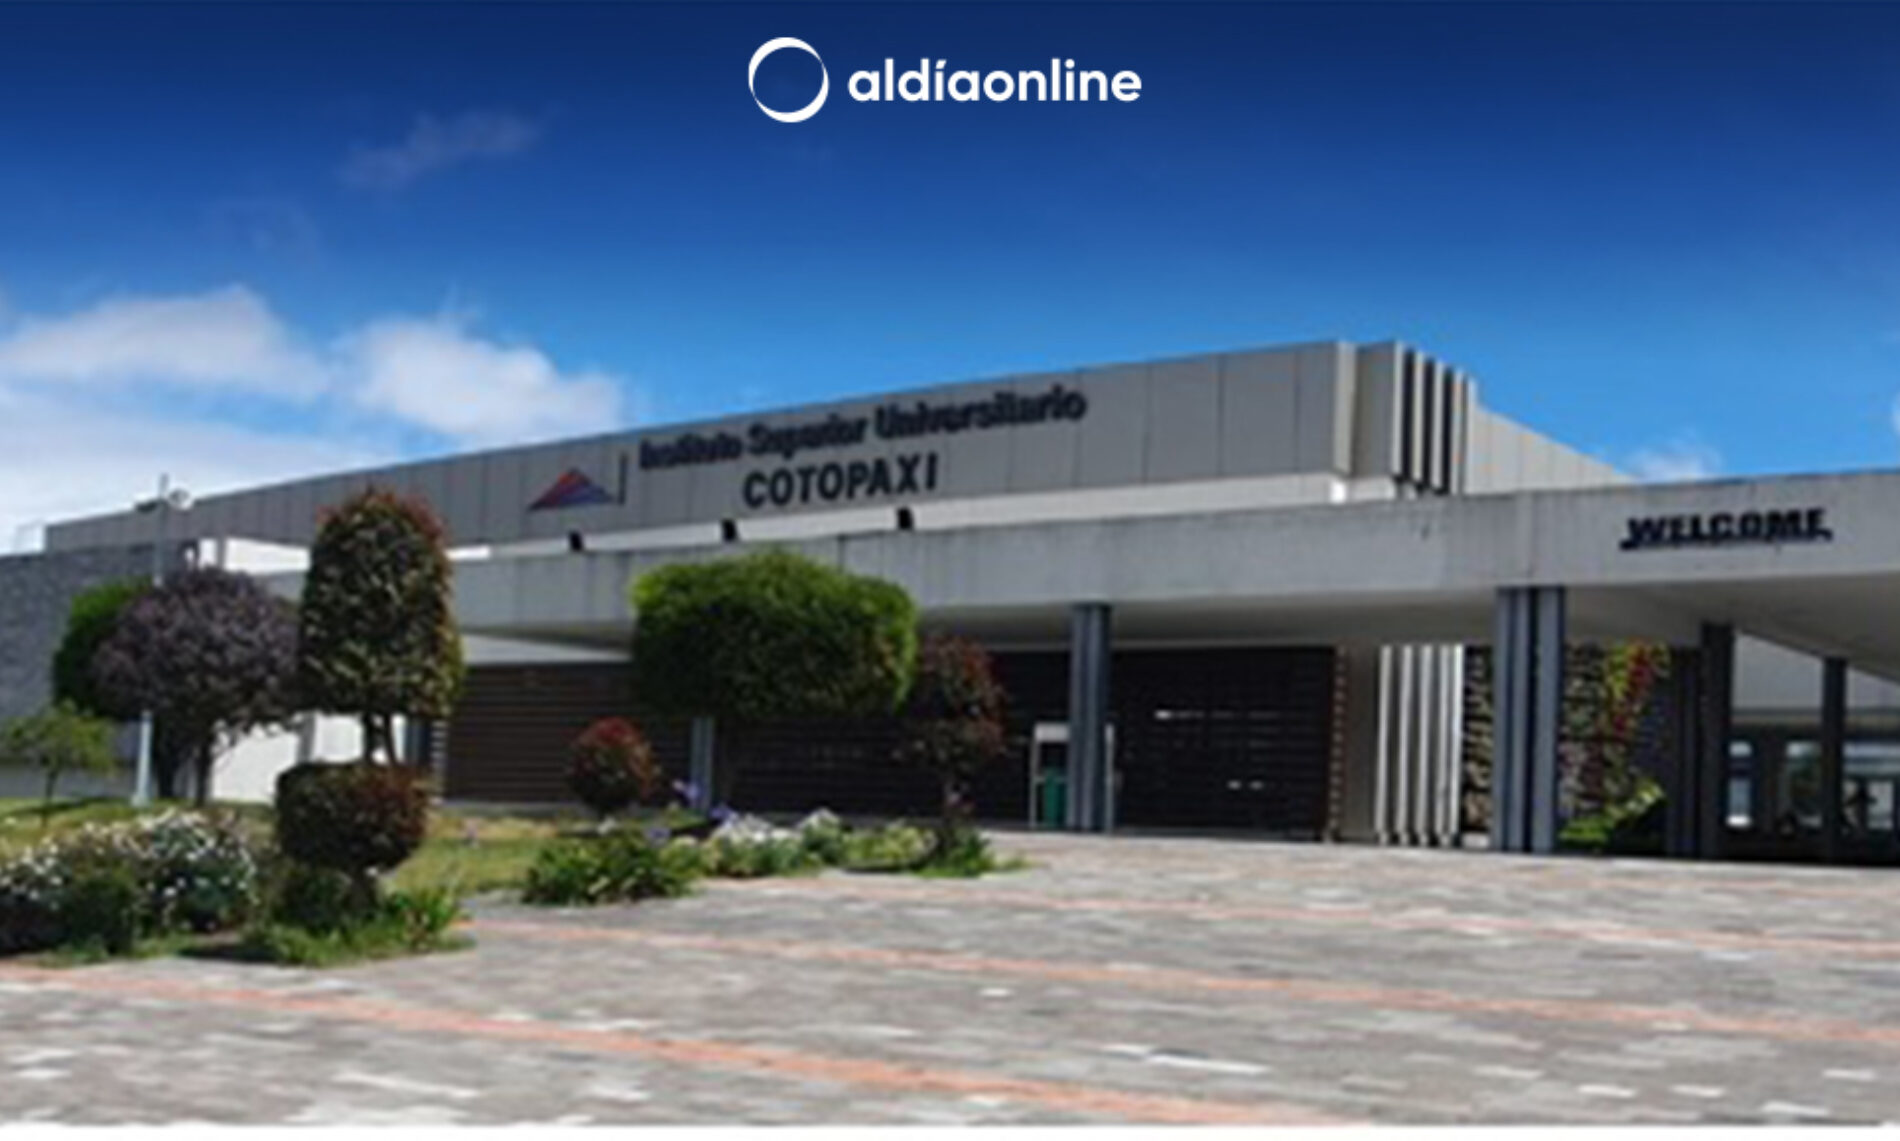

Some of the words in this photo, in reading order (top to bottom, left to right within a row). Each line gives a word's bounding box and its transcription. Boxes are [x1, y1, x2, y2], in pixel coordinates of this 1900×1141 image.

[748, 414, 867, 459] Superior
[874, 384, 1088, 440] Universitario
[742, 453, 939, 508] COTOPAXI
[1620, 508, 1834, 550] WELCOME
